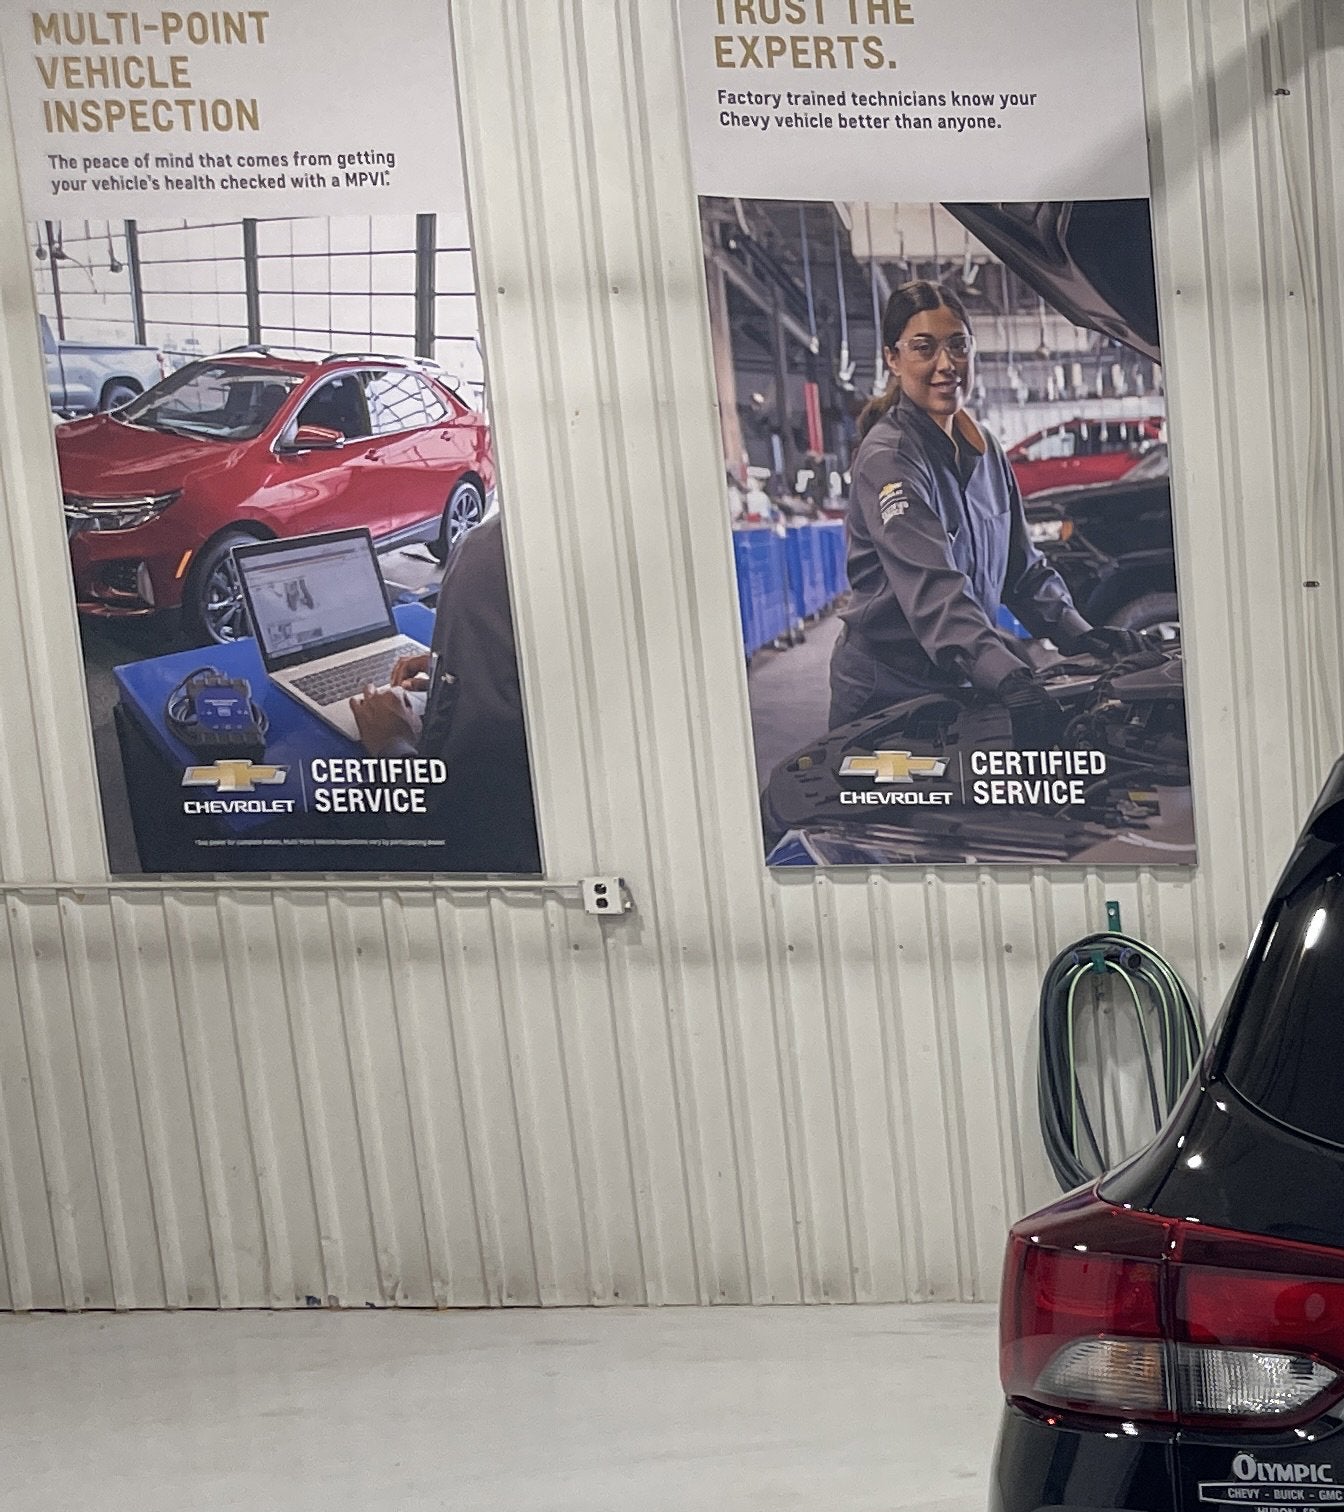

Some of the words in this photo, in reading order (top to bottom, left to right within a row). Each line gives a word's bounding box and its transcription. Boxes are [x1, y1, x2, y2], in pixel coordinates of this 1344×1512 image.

[715, 0, 825, 25] TRUST
[849, 0, 915, 25] THE
[32, 11, 269, 45] MULTI-POINT
[714, 35, 897, 69] EXPERTS.
[35, 55, 192, 90] VEHICLE
[717, 89, 782, 109] Factory
[786, 90, 846, 107] trained
[851, 90, 947, 107] technicians
[951, 90, 995, 107] know
[999, 93, 1037, 110] your
[43, 98, 260, 133] INSPECTION
[719, 111, 770, 131] Chevy
[774, 112, 833, 129] vehicle
[838, 112, 890, 129] better
[894, 112, 932, 129] than
[937, 115, 1002, 132] anyone.
[48, 154, 78, 169] The
[83, 156, 129, 173] peace
[134, 152, 150, 168] of
[155, 152, 194, 168] mind
[198, 152, 233, 168] that
[237, 154, 289, 167] comes
[293, 151, 332, 167] from
[337, 149, 395, 169] getting
[51, 178, 87, 195] your
[92, 174, 160, 191] vehicle's
[164, 174, 215, 190] health
[220, 173, 286, 189] checked
[291, 172, 326, 188] with
[331, 176, 340, 187] a
[311, 758, 447, 784] CERTIFIED
[970, 751, 1106, 775] CERTIFIED
[314, 788, 427, 813] SERVICE
[839, 791, 953, 805] CHEVROLET
[973, 780, 1085, 805] SERVICE
[183, 799, 295, 814] CHEVROLET
[1232, 1452, 1333, 1482] OLYMPIC
[1228, 1488, 1259, 1499] CHEVY
[1274, 1489, 1304, 1500] BUICK
[1319, 1490, 1343, 1501] GMC
